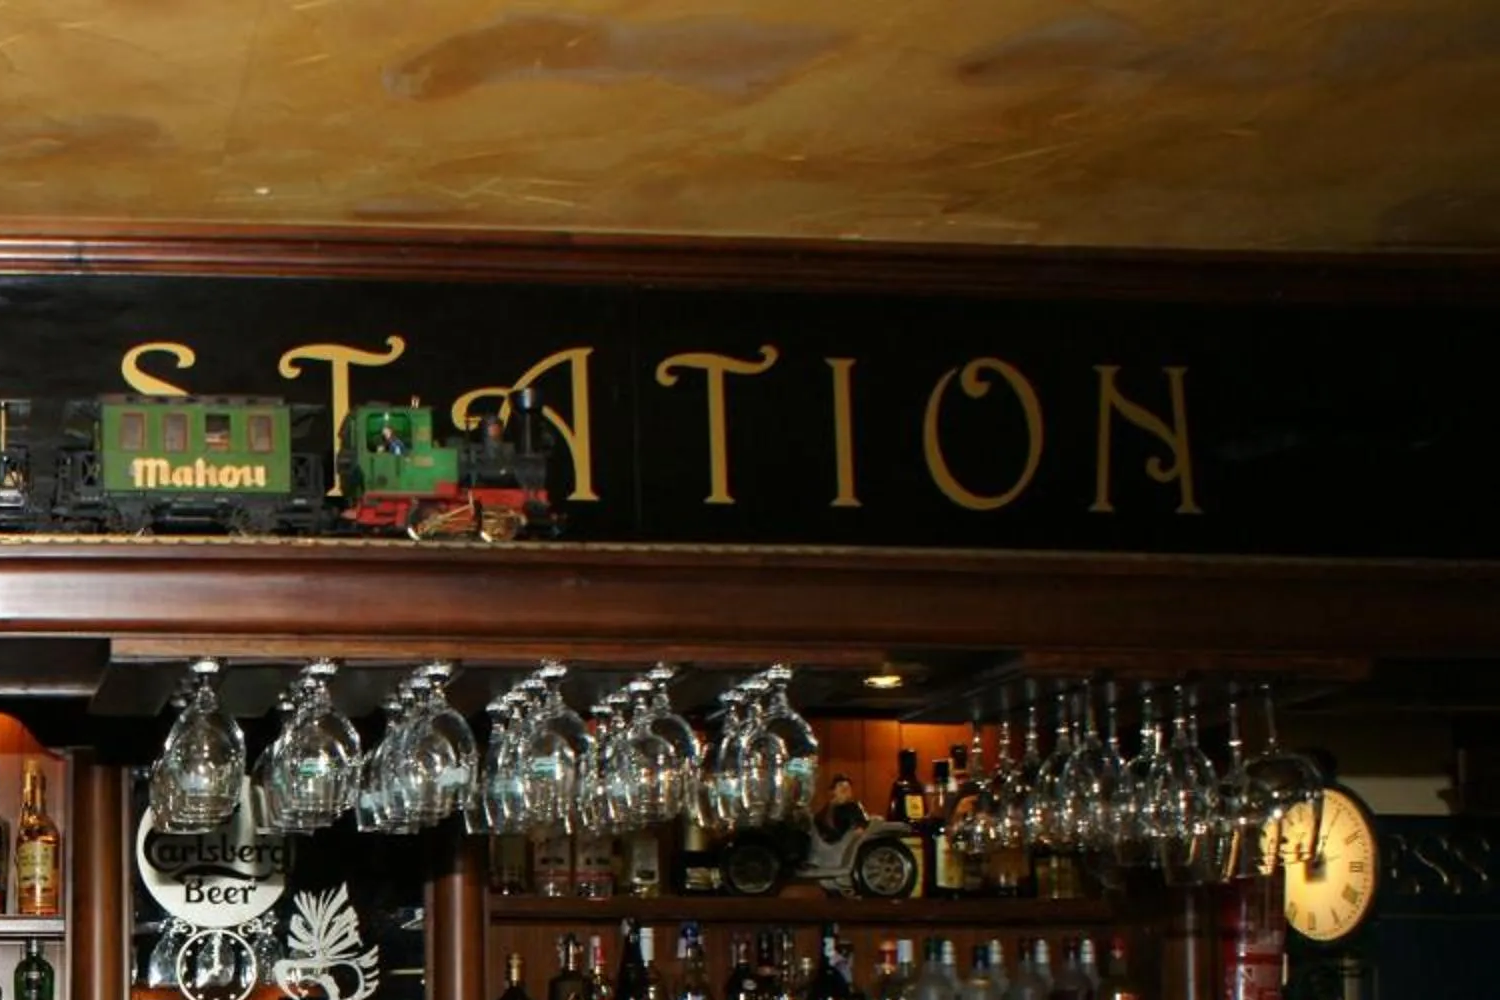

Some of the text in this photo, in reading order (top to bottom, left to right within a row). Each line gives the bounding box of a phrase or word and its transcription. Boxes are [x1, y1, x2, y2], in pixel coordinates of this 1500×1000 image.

[132, 456, 266, 488] Mahou
[143, 829, 287, 875] Carlsberg
[184, 877, 257, 905] Beer
